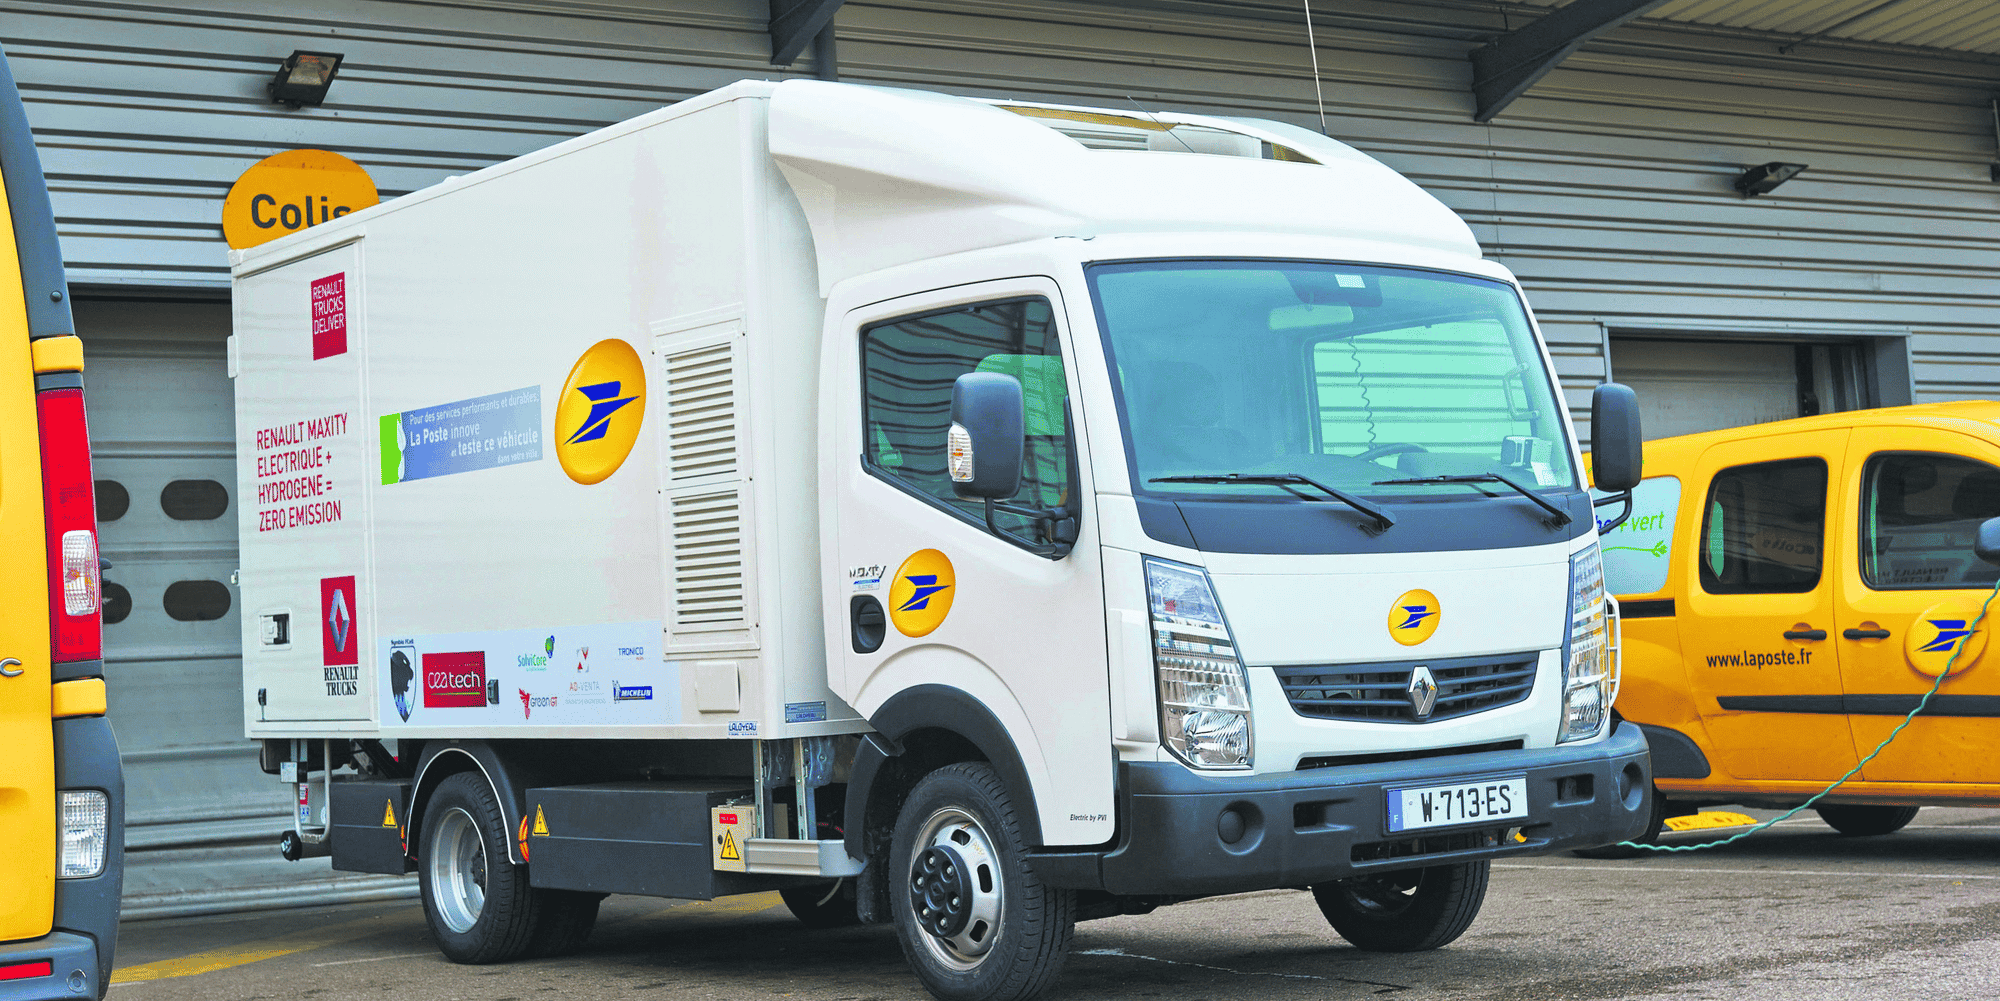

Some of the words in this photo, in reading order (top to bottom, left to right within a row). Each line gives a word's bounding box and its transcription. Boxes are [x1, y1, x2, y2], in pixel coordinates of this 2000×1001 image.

[313, 279, 343, 300] RENAULT
[314, 295, 344, 317] TRUCKS
[314, 312, 345, 335] DELIVER
[410, 414, 424, 425] Pour
[425, 411, 435, 423] des
[436, 407, 461, 421] services
[462, 400, 500, 416] performants
[501, 397, 508, 408] et
[257, 421, 304, 451] RENAULT
[307, 412, 348, 441] MAXITY
[410, 430, 420, 447] La
[424, 426, 448, 445] Poste
[450, 423, 480, 439] innove
[458, 441, 481, 456] teste
[485, 438, 495, 451] ce
[497, 428, 538, 449] véhicule
[258, 446, 322, 478] ELECTRIQUE
[326, 451, 332, 464] +
[258, 474, 323, 505] HYDROGENE
[259, 508, 286, 532] ZERO
[289, 499, 341, 528] EMISSION
[1632, 511, 1664, 531] vert
[618, 646, 644, 656] TRONICO
[1706, 648, 1812, 670] www.laposte.fr
[324, 666, 359, 681] RENAULT
[326, 681, 357, 696] TRUCKS
[621, 689, 652, 697] MICHELIN
[1070, 813, 1088, 821] Electric
[1089, 814, 1097, 822] by
